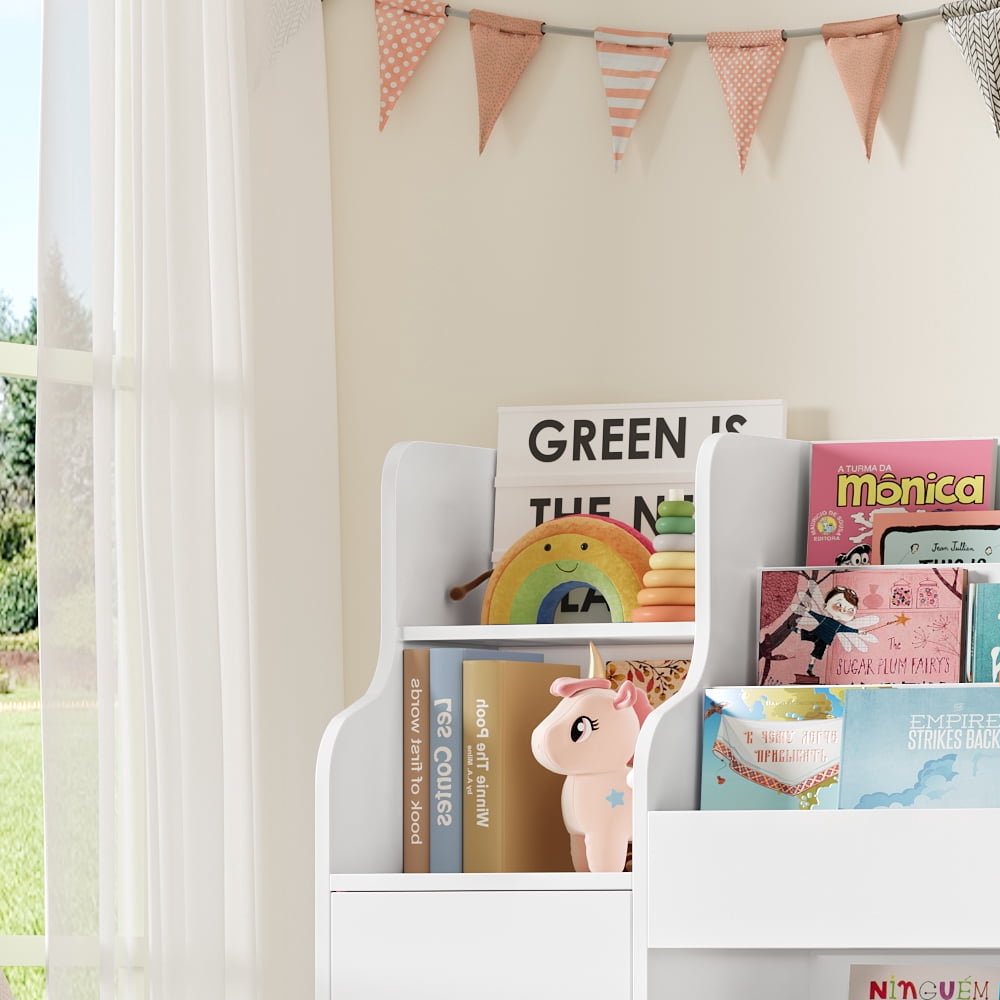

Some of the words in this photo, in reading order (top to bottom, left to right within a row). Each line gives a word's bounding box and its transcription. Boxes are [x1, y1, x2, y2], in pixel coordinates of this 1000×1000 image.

[528, 416, 687, 463] GREEN
[837, 465, 845, 473] A
[845, 464, 878, 473] TURMA
[879, 464, 892, 472] DA
[888, 636, 902, 650] The
[836, 657, 874, 676] SUGAR
[878, 657, 907, 675] PLUM
[911, 656, 950, 674] FAIRY'S
[907, 729, 963, 750] STRIKES
